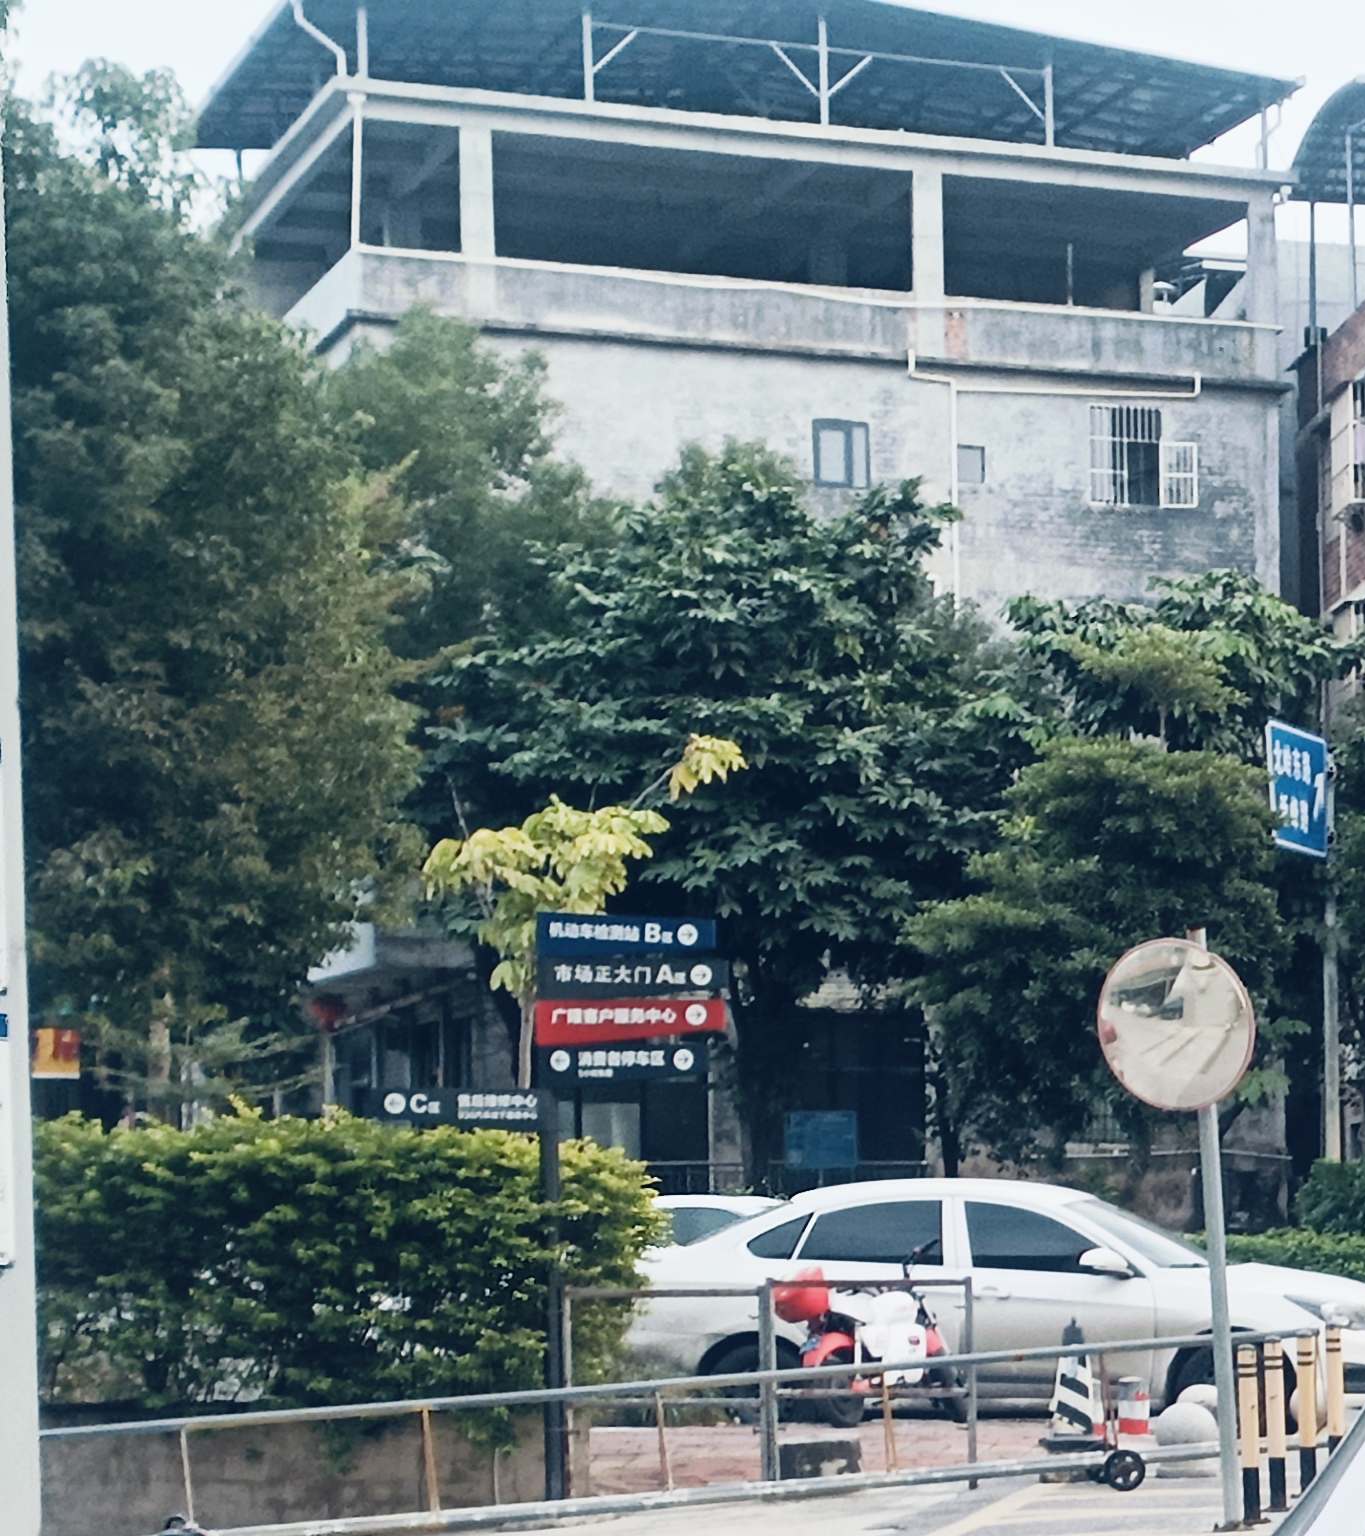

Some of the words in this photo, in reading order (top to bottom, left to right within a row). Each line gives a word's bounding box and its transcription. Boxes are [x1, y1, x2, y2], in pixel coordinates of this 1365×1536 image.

[554, 964, 652, 984] 市场正大门
